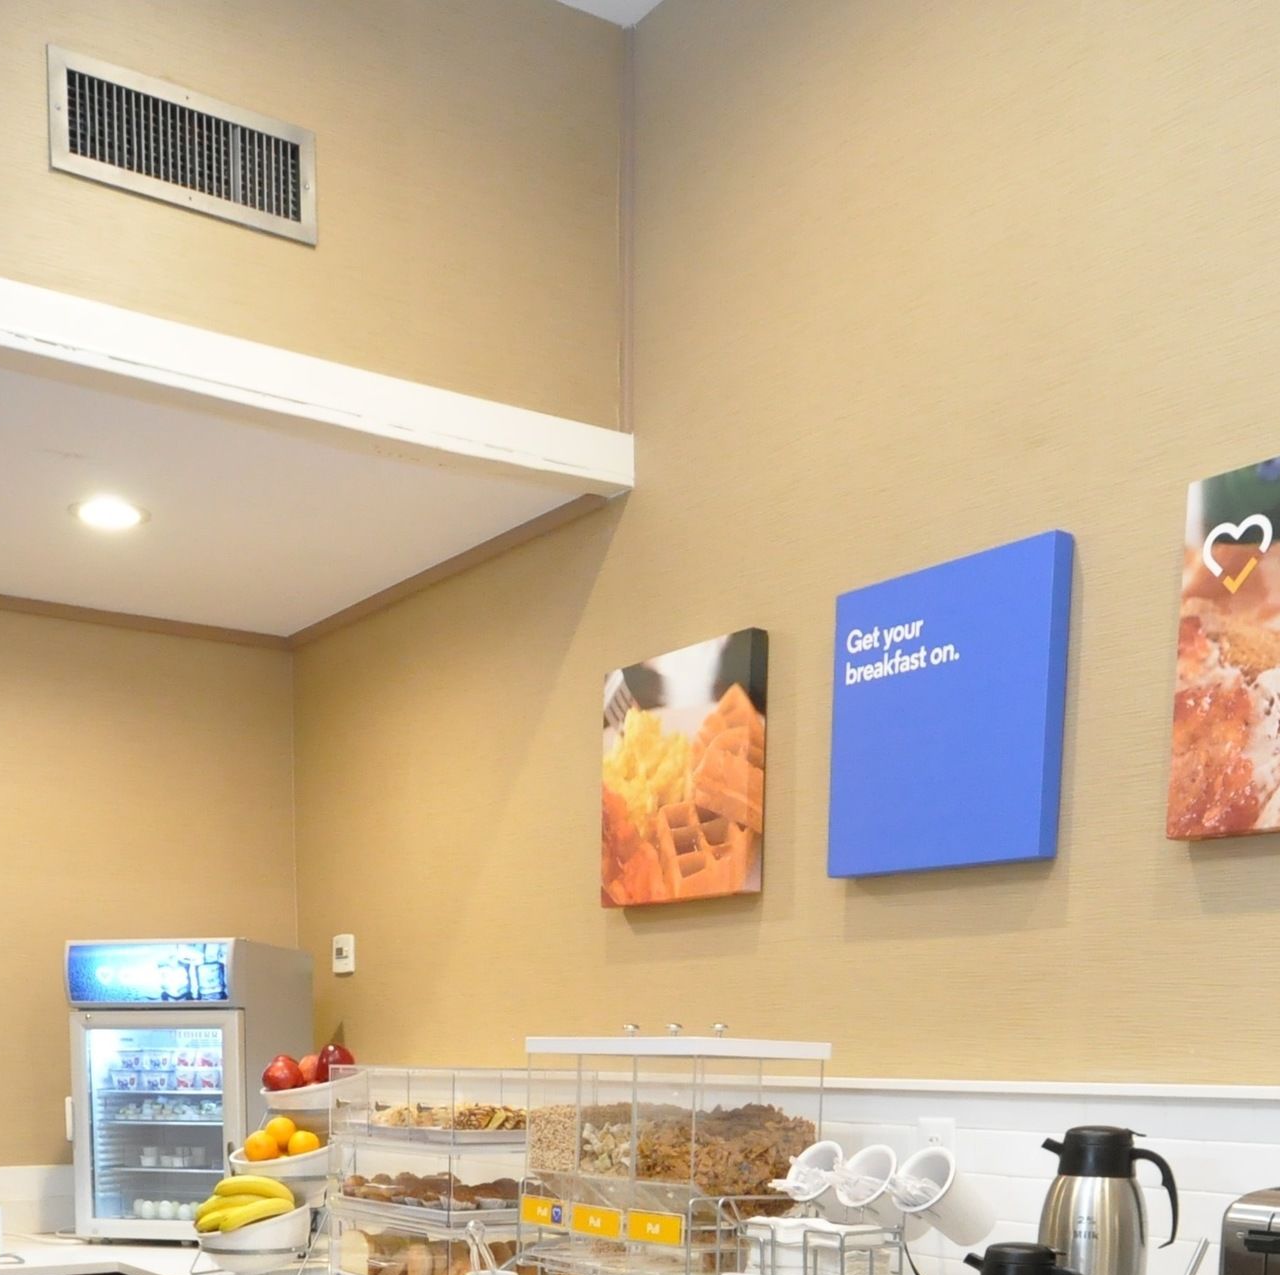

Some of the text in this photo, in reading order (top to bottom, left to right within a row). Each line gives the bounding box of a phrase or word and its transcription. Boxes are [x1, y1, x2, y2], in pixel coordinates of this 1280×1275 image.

[846, 619, 924, 654] Get your
[845, 643, 960, 686] breakfast on.
[1073, 1230, 1098, 1240] Milk
